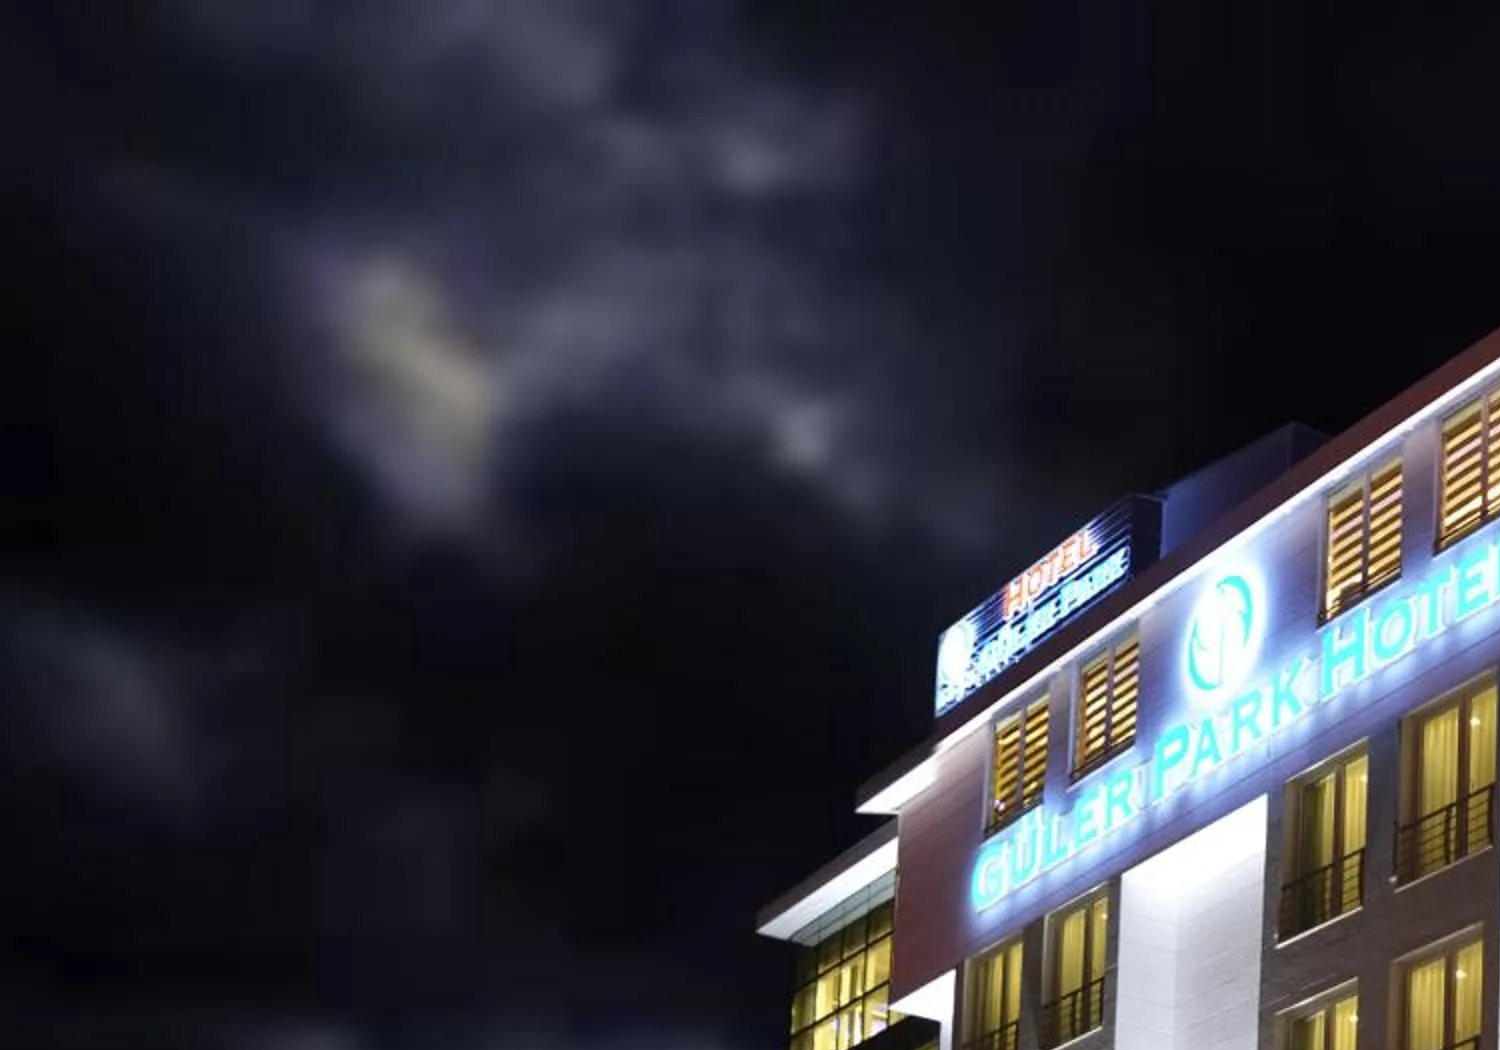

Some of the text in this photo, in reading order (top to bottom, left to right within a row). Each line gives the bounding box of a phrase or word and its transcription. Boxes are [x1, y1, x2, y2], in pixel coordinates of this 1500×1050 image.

[1003, 531, 1094, 619] HOTEL
[971, 769, 1137, 912] GÜLER
[1154, 660, 1303, 801] PARK
